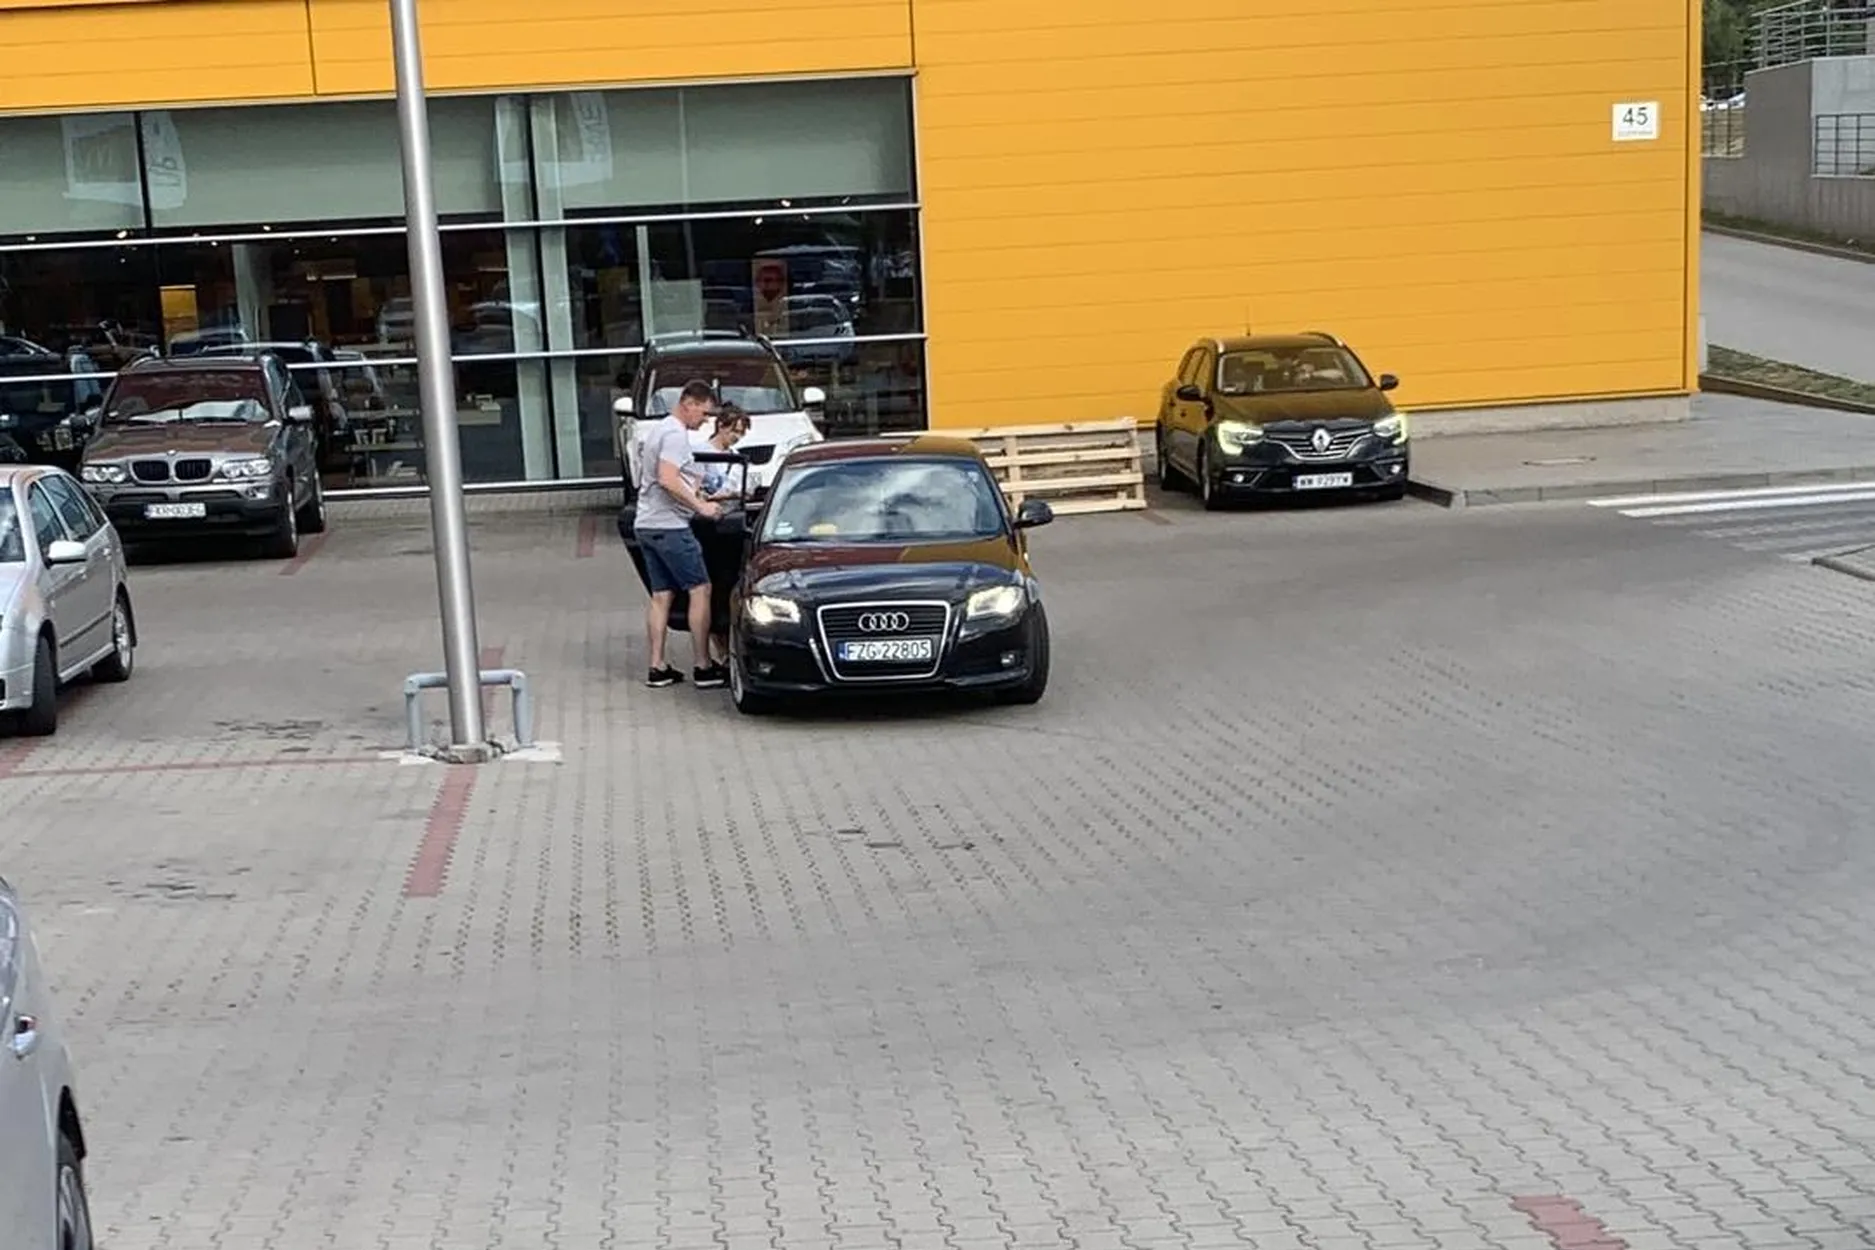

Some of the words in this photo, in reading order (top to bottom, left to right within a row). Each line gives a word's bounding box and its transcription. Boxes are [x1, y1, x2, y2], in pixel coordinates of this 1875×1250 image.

[1622, 106, 1649, 126] 45
[847, 643, 877, 660] FZG
[881, 641, 929, 659] 22805
